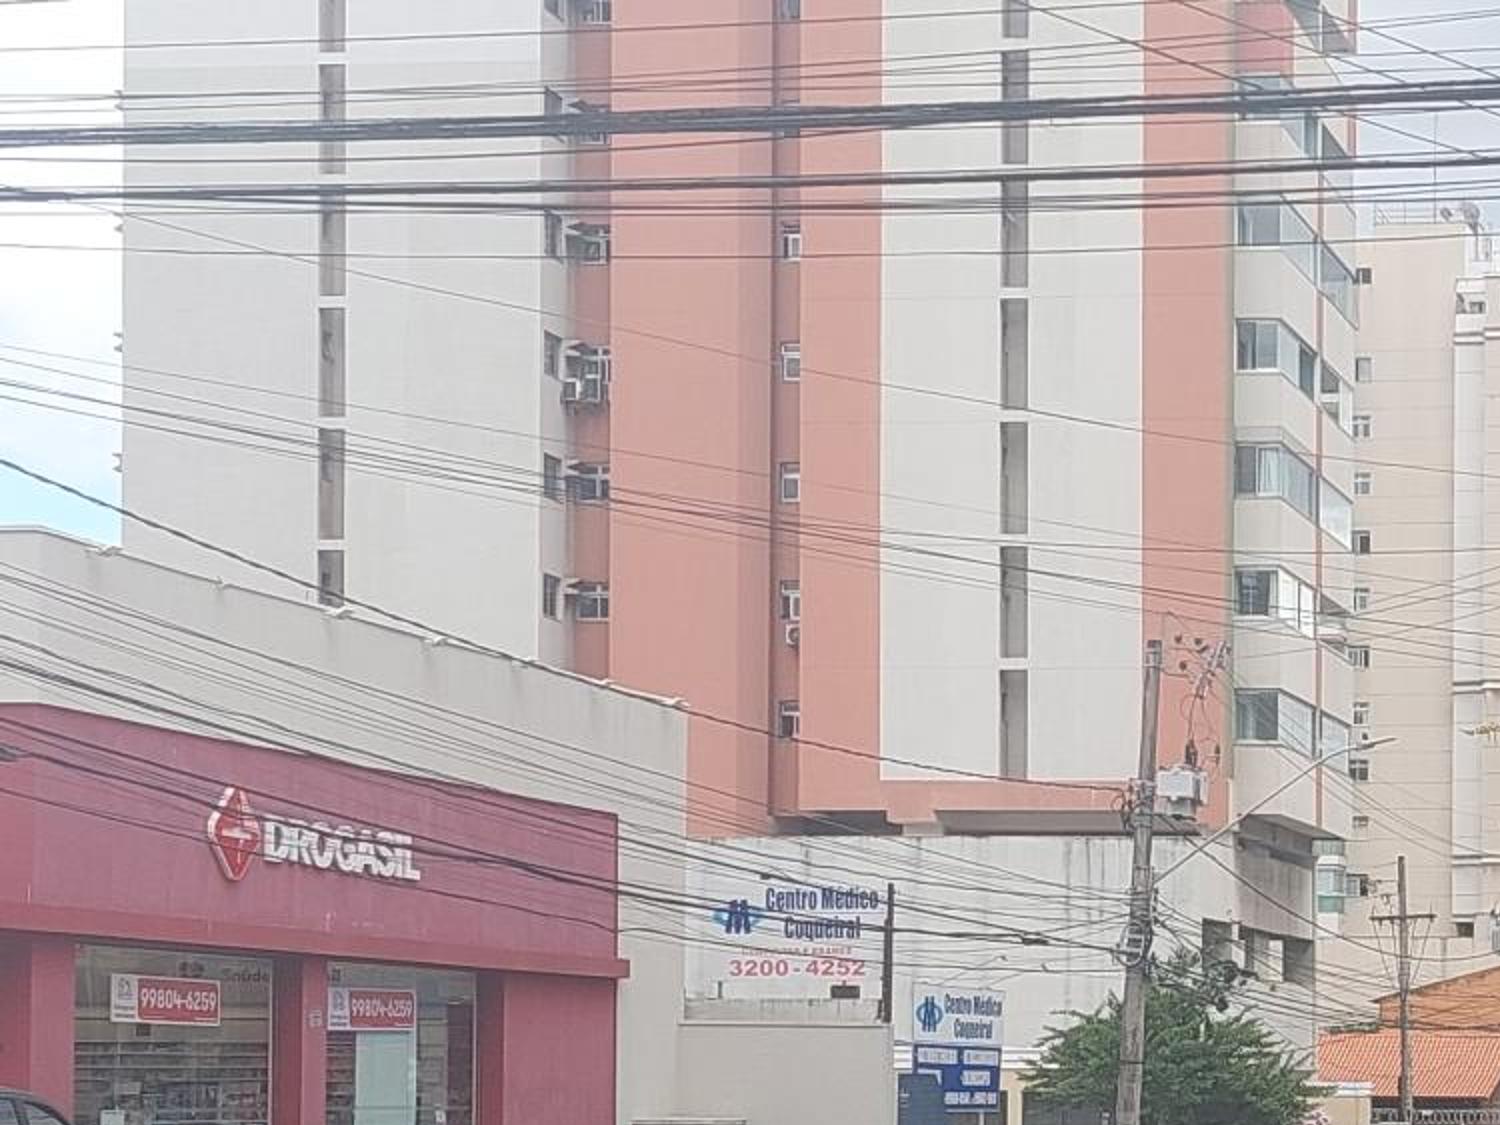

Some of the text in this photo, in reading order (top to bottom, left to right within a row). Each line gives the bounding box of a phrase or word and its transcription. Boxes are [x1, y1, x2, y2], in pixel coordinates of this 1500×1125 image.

[263, 814, 421, 881] DROGASIL
[765, 887, 817, 911] Centro
[783, 916, 861, 941] Coqueiral
[729, 959, 789, 977] 3200
[805, 959, 866, 977] 4252
[140, 987, 218, 1010] 99804-6259
[351, 998, 413, 1018] 99804-6259
[944, 992, 972, 1015] Centro
